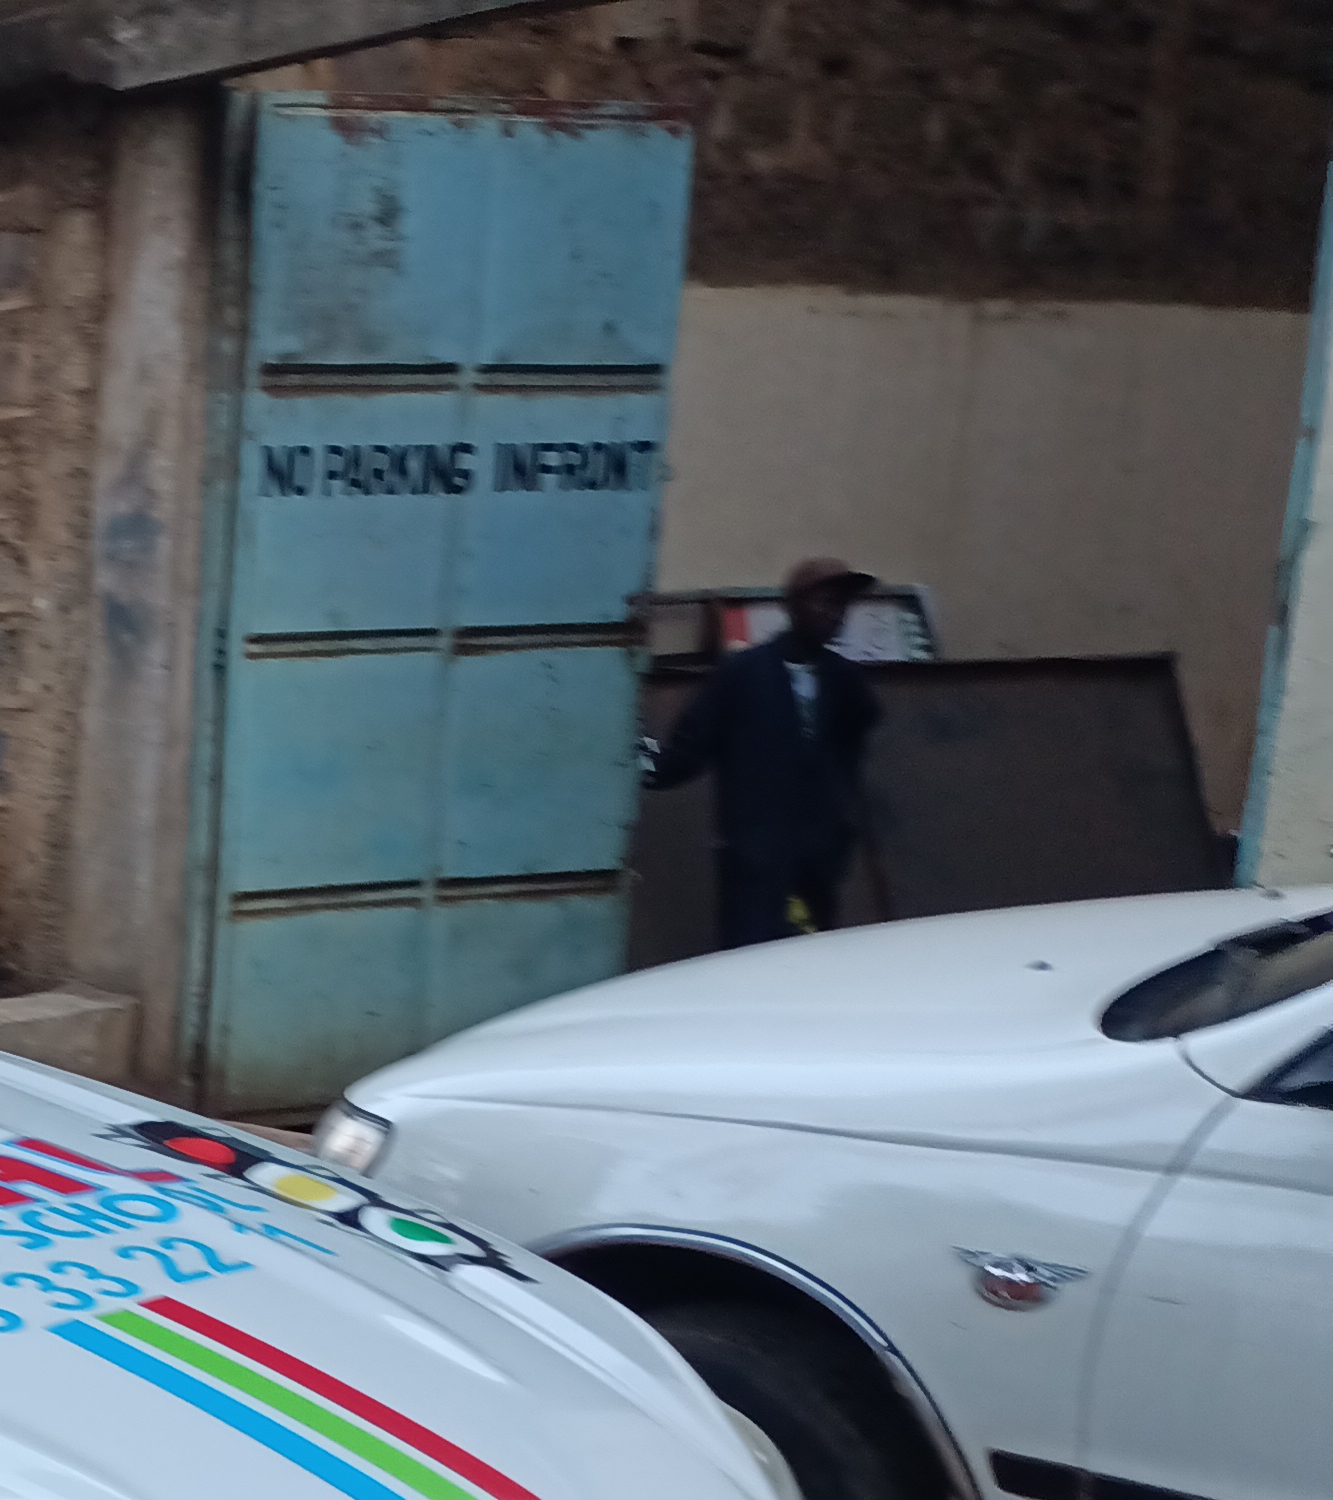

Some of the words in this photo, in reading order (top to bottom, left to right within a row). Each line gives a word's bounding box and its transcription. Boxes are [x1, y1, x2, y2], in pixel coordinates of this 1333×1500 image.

[257, 444, 312, 497] NO
[320, 441, 480, 496] PARKING
[113, 1236, 257, 1285] 22
